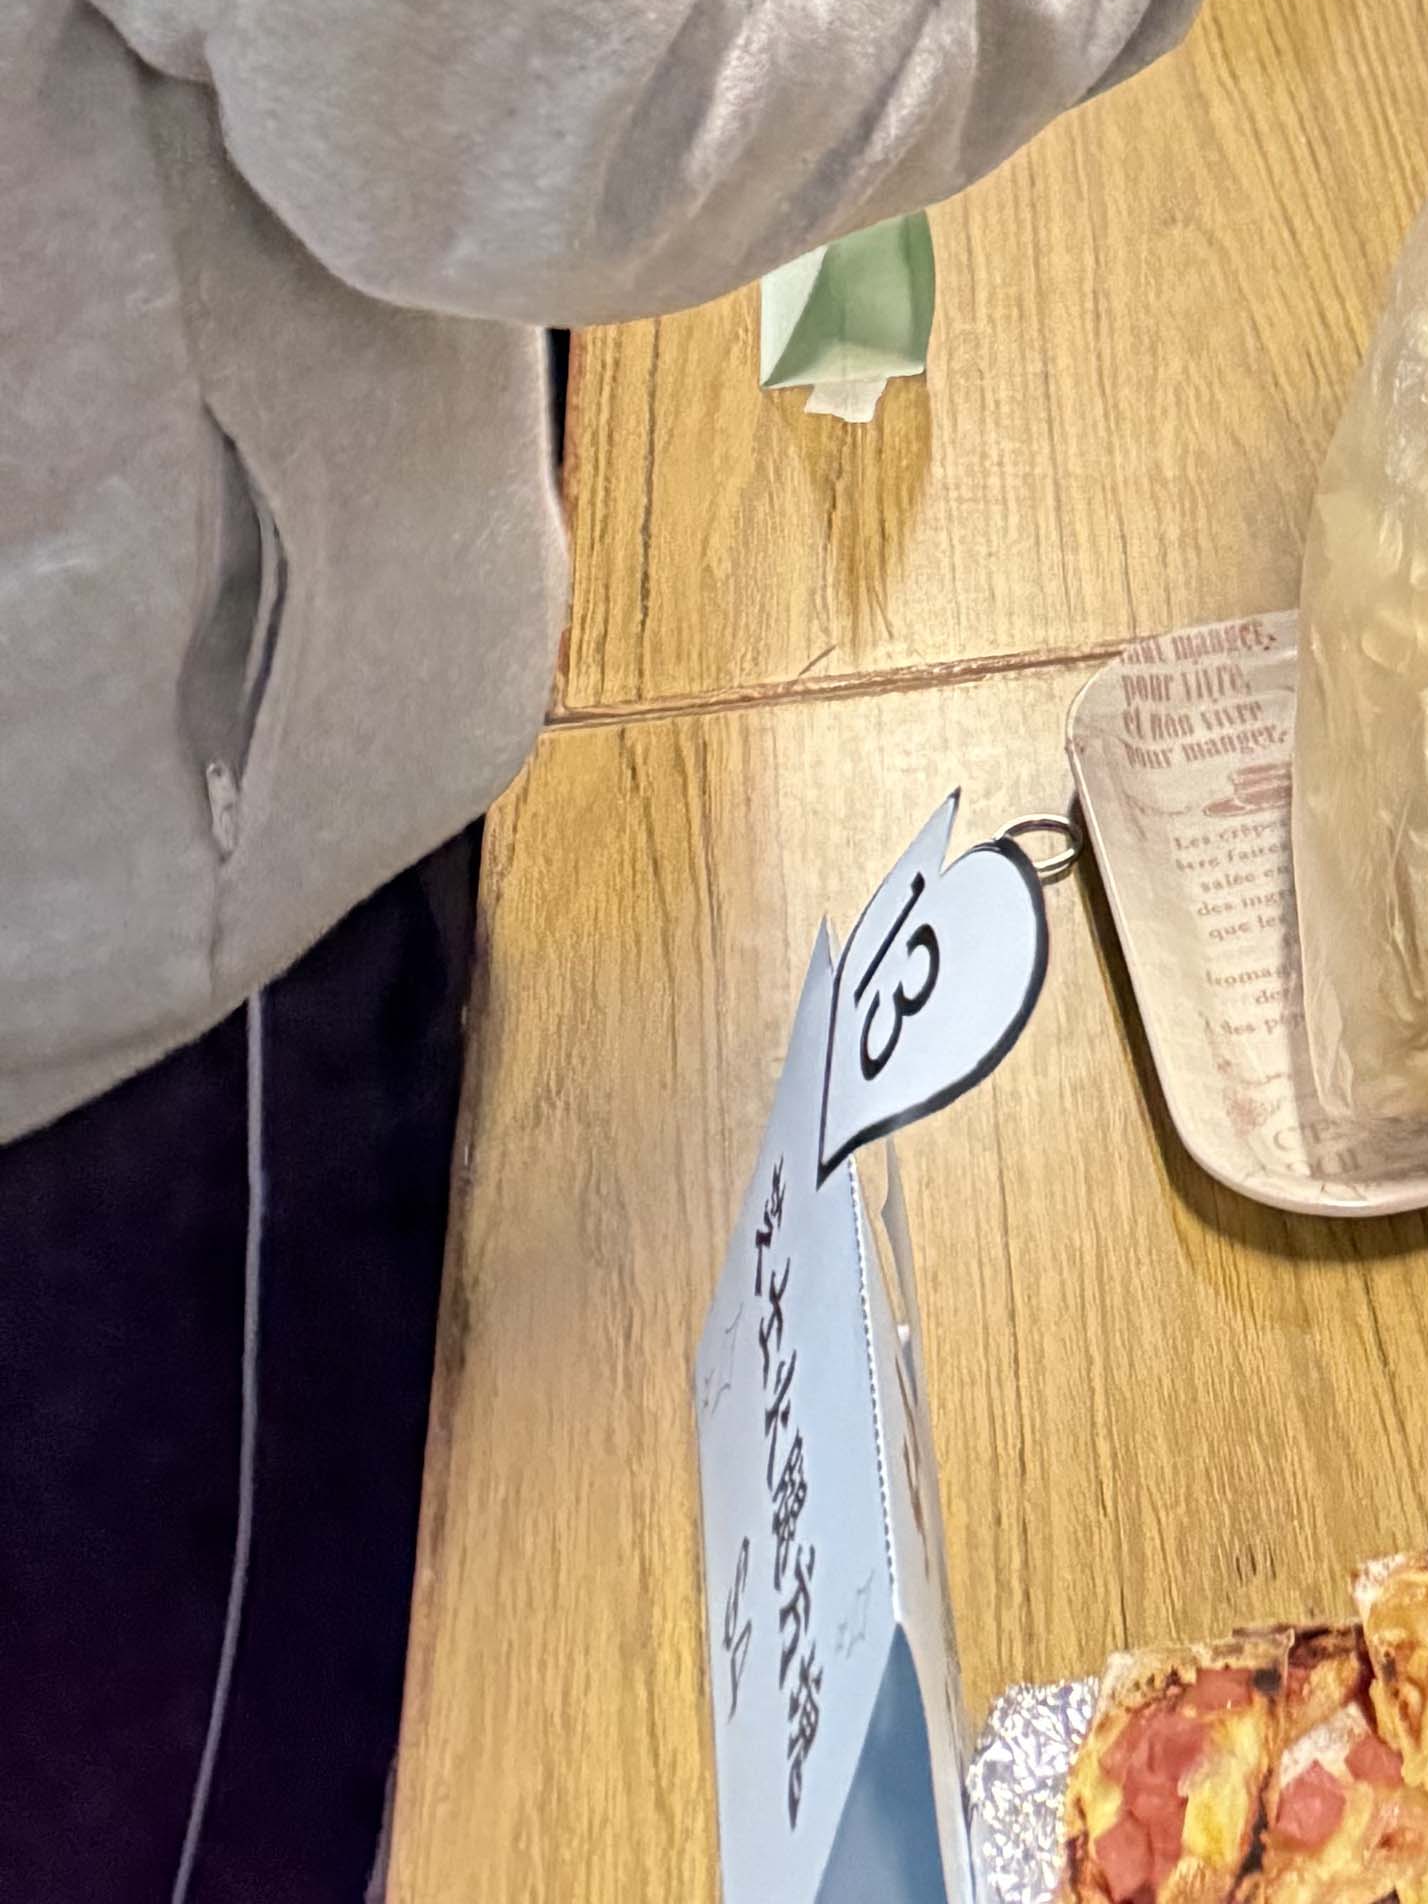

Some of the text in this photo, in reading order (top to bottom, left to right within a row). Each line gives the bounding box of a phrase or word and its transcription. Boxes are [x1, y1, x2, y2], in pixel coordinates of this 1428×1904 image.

[1121, 672, 1175, 707] pour
[1150, 710, 1196, 742] non
[853, 869, 942, 1083] 13
